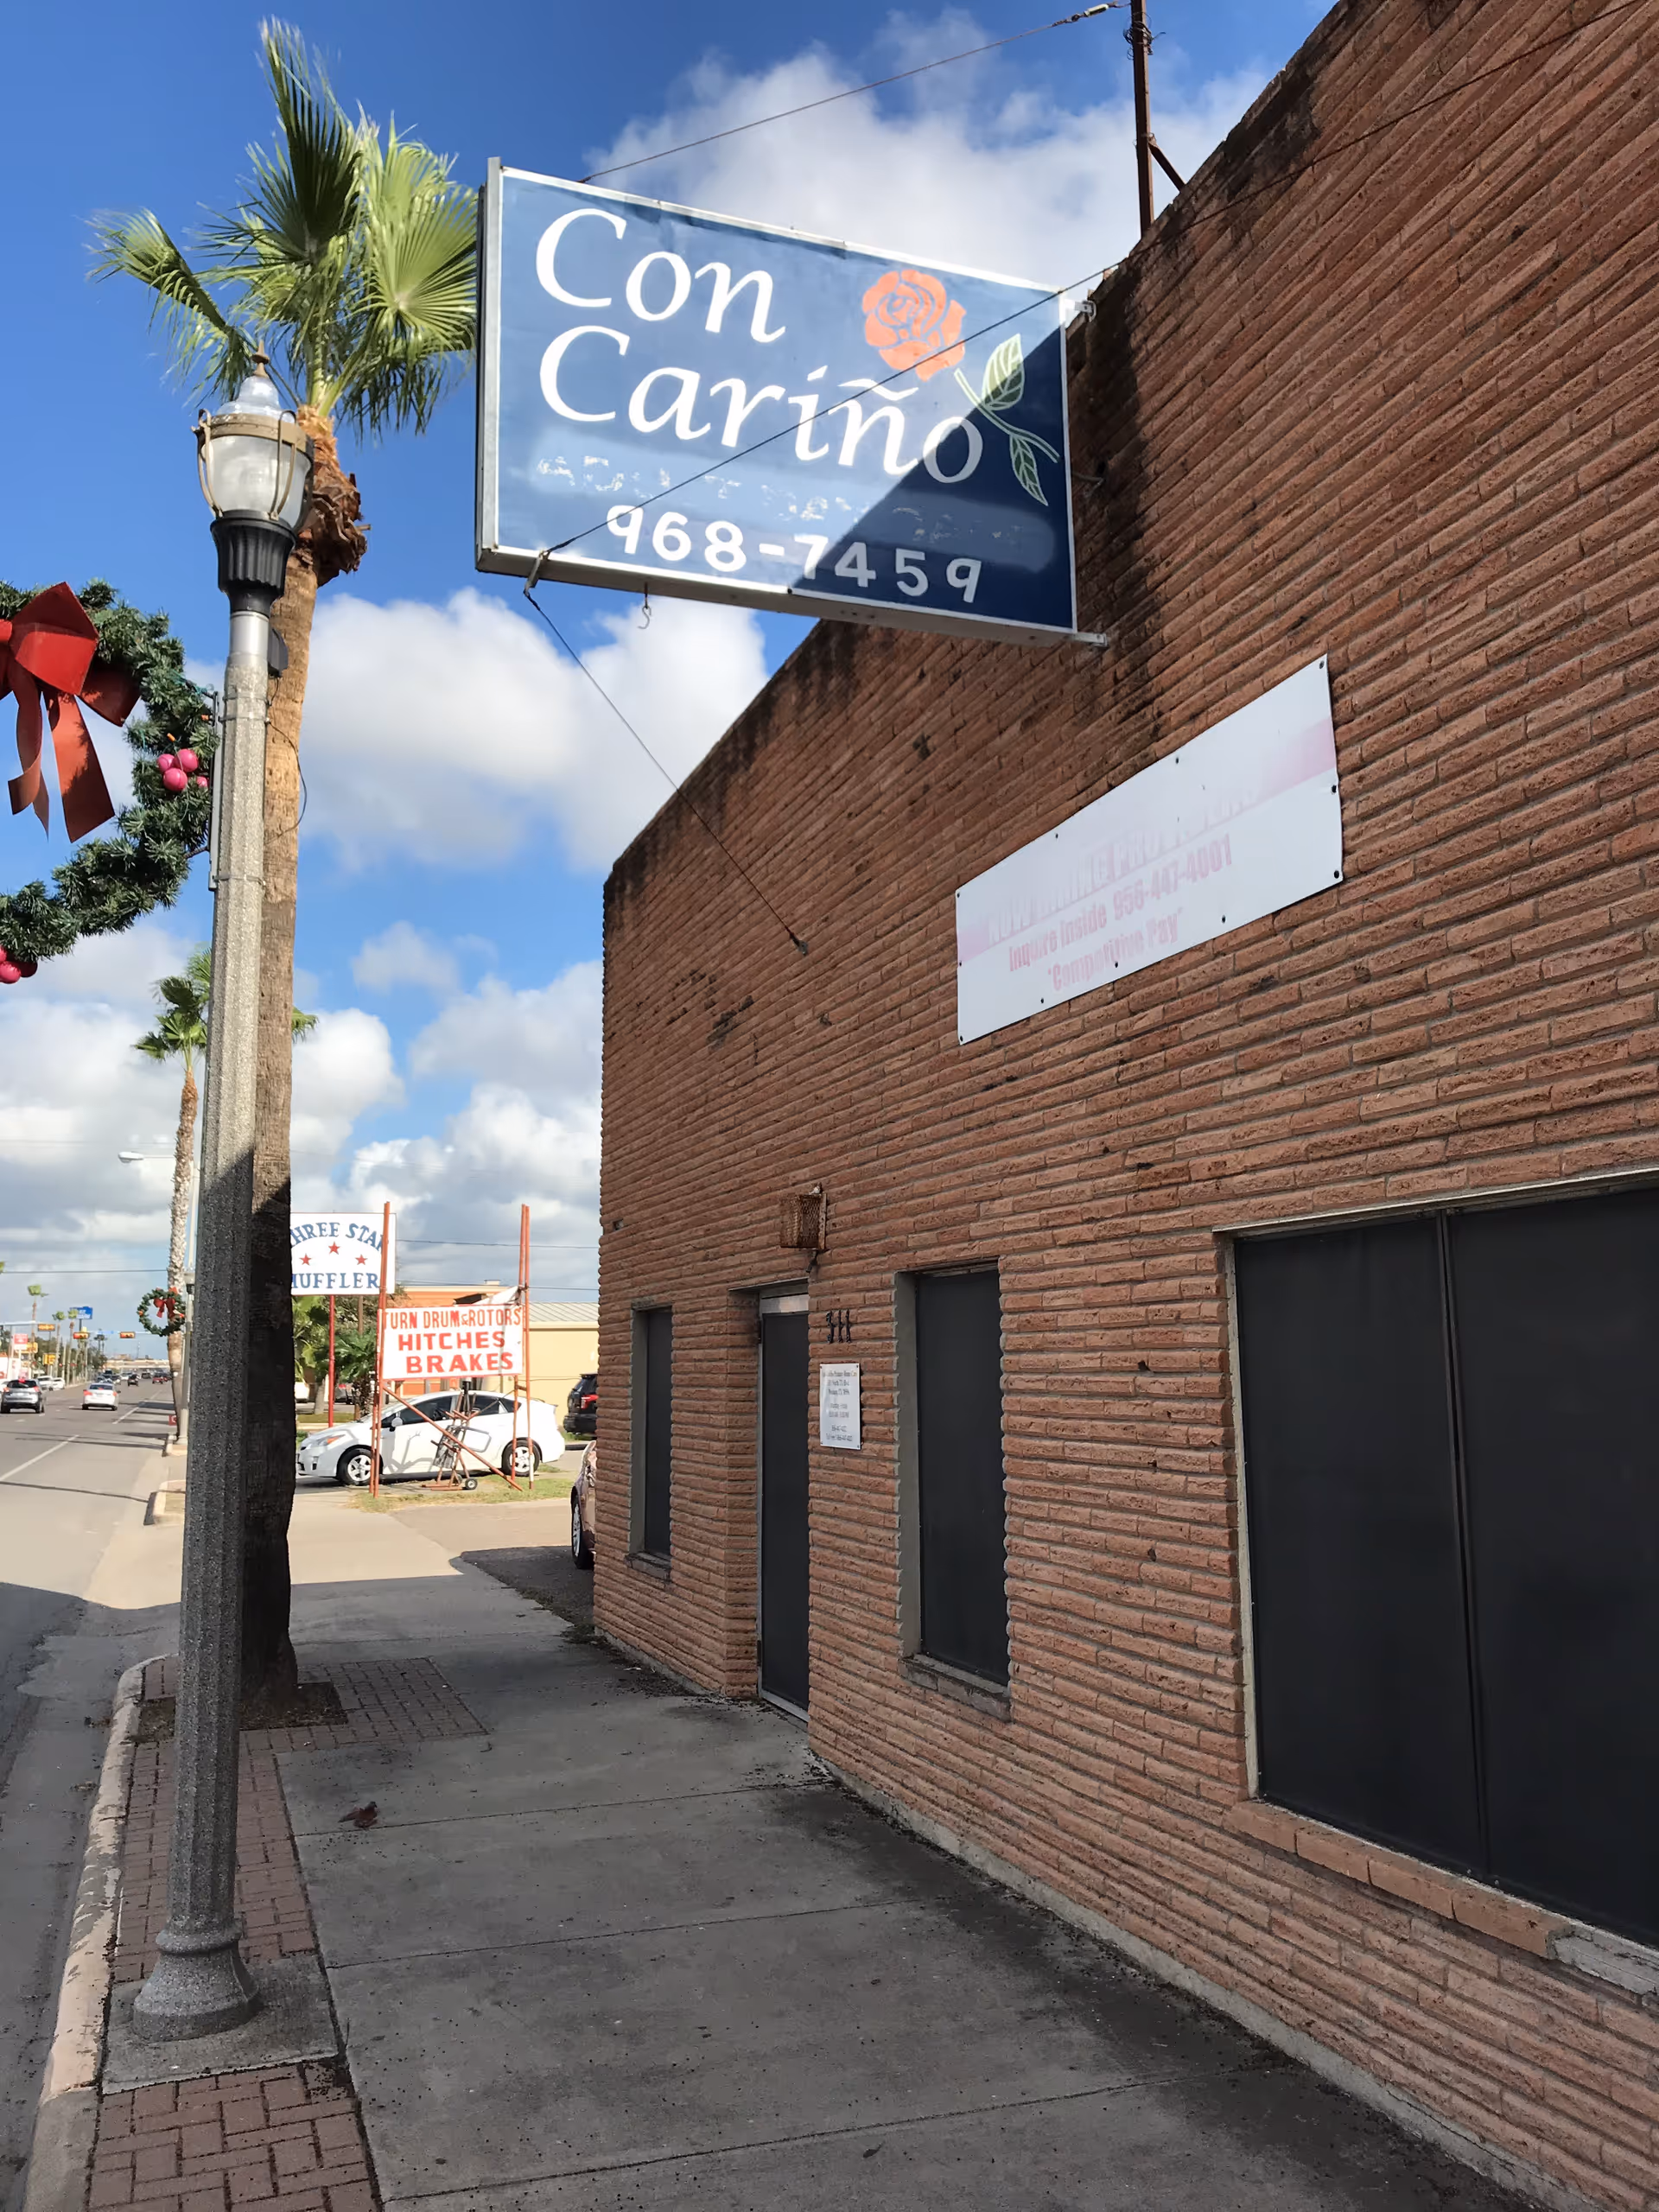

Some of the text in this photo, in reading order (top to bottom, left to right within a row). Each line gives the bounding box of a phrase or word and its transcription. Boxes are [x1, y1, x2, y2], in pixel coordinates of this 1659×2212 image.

[535, 207, 786, 344] Con
[538, 324, 983, 484] Cariño
[606, 503, 982, 605] 968-7459
[290, 1222, 340, 1247] HREE
[397, 1331, 505, 1351] HITCHES
[406, 1351, 514, 1374] BRAKES
